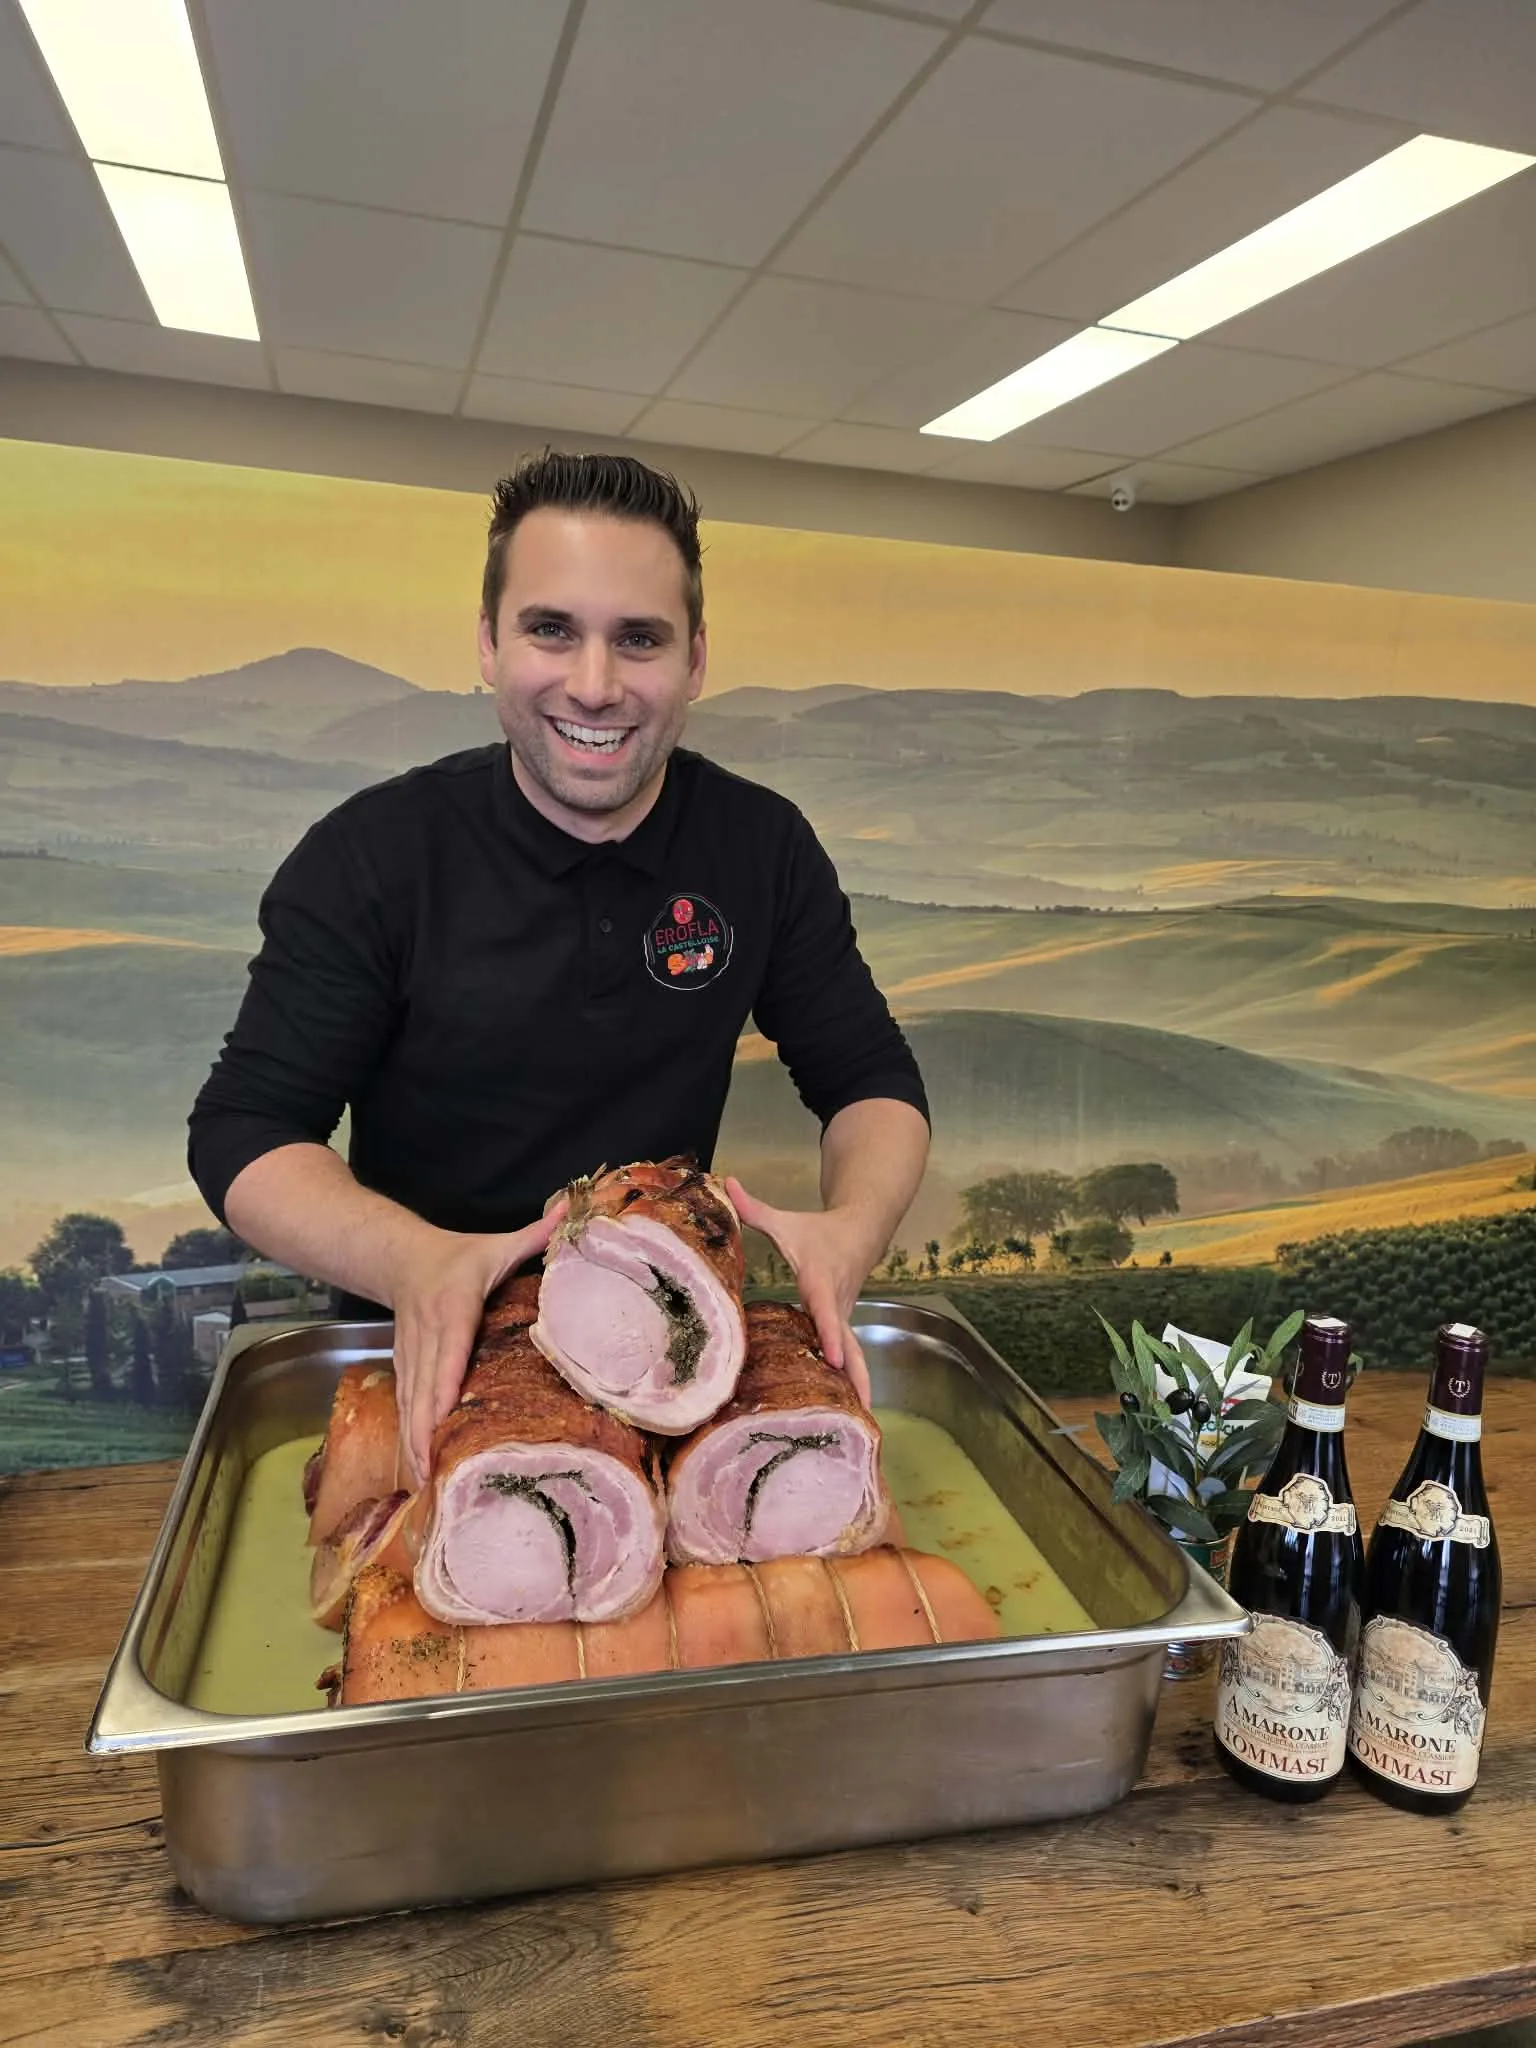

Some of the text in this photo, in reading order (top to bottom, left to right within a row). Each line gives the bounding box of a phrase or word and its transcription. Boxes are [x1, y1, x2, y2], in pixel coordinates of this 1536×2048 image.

[655, 919, 720, 946] EROFLA
[1328, 1373, 1337, 1385] T
[1455, 1380, 1466, 1393] T
[1224, 1694, 1330, 1742] AMARONE
[1352, 1696, 1457, 1753] AMARONE
[1223, 1722, 1328, 1775] TOMMASI
